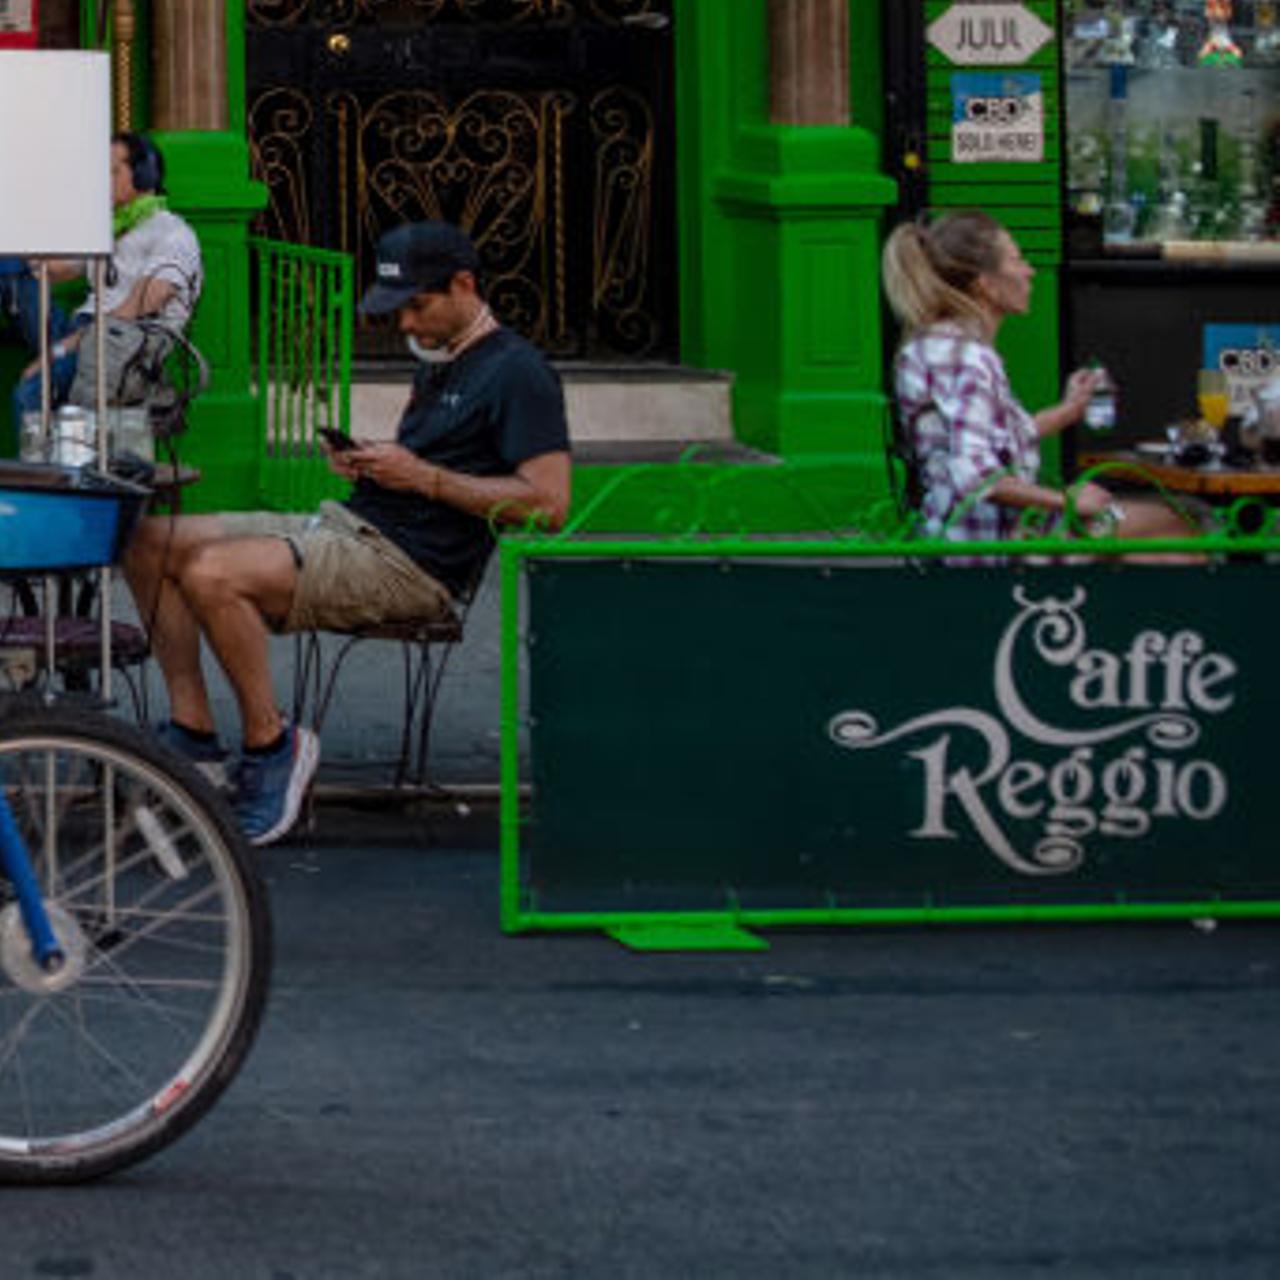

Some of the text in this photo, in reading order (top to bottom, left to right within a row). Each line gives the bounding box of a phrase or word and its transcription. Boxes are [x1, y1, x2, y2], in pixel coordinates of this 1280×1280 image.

[956, 17, 1023, 51] JUUL
[995, 585, 1238, 747] Caffe
[828, 707, 1228, 875] Reggio
